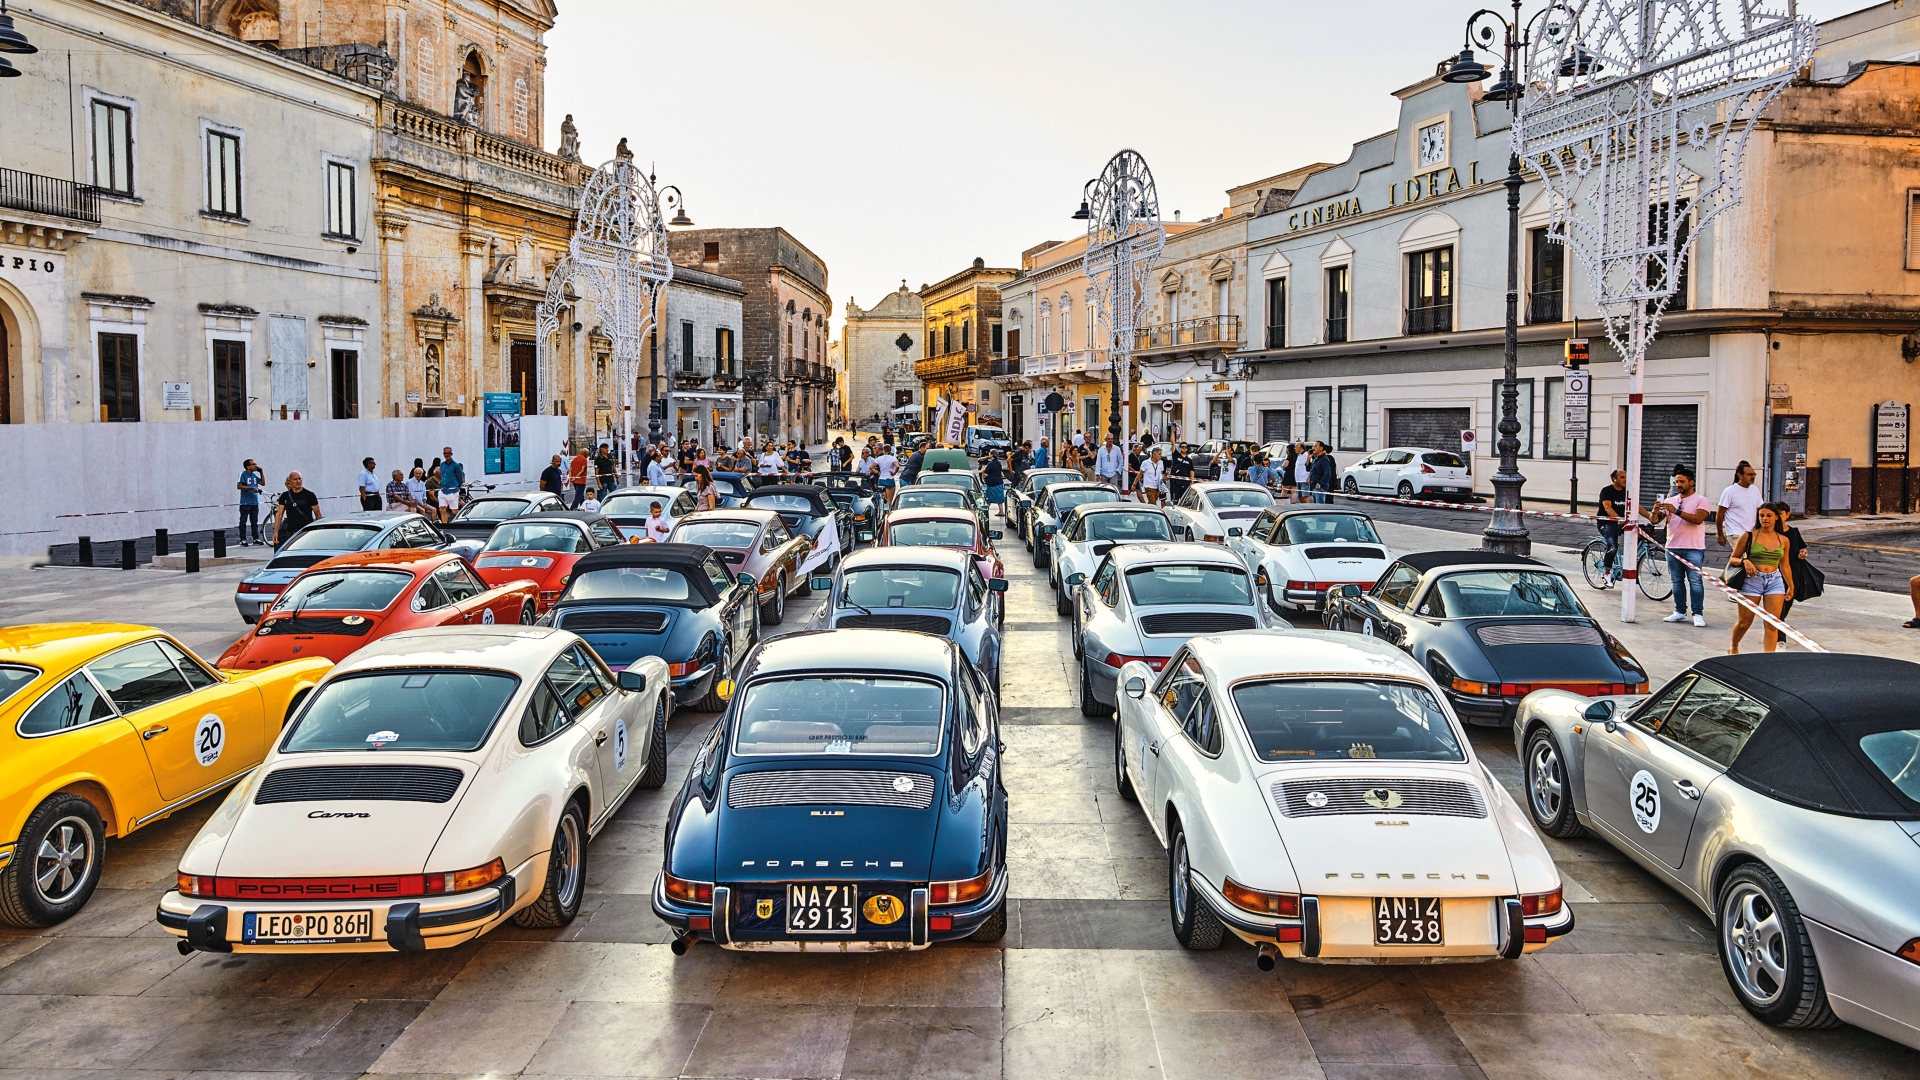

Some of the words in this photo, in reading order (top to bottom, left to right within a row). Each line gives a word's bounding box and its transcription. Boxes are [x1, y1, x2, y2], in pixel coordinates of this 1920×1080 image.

[1288, 197, 1362, 231] CINEMA
[1389, 161, 1484, 207] IDEAL
[1040, 403, 1047, 413] P
[200, 722, 222, 754] 20
[618, 729, 625, 758] 5
[1635, 782, 1657, 818] 25
[308, 810, 371, 819] Carrera
[741, 860, 904, 868] PORSCHE
[1325, 872, 1490, 880] PORSCHE
[238, 882, 398, 895] PORSCHE
[793, 885, 849, 907] NA71
[257, 916, 292, 937] LEO
[333, 914, 368, 936] 86H
[792, 908, 853, 930] 4913
[1379, 919, 1440, 943] 3438
